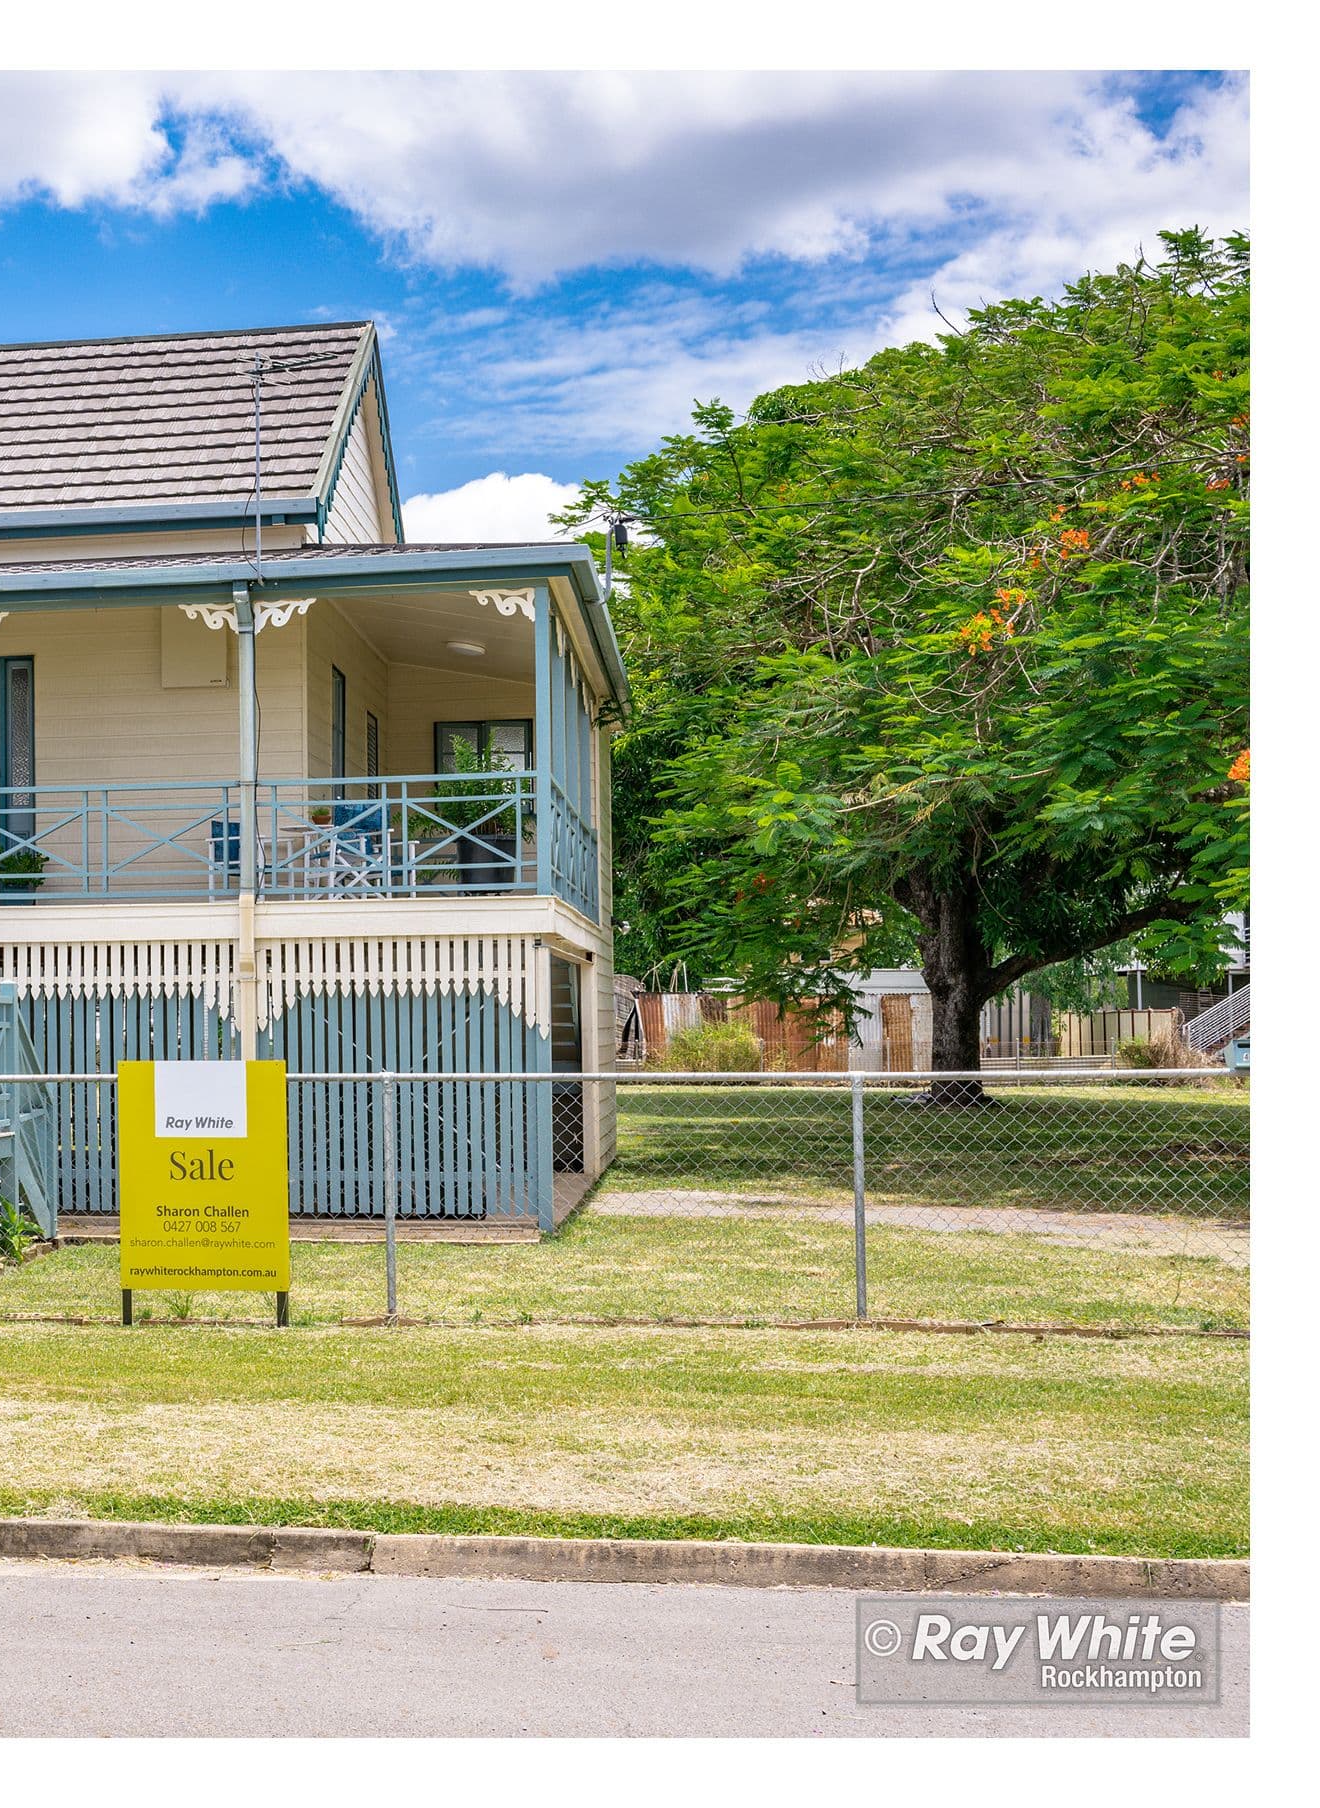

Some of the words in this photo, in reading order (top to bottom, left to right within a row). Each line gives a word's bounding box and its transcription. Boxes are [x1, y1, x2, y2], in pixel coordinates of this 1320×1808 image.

[166, 1116, 192, 1131] Ray
[195, 1116, 233, 1129] White
[170, 1149, 234, 1181] Sale
[156, 1205, 200, 1217] Sharon
[204, 1206, 249, 1218] Challen
[163, 1220, 191, 1232] 0427
[195, 1220, 217, 1233] 008
[220, 1221, 241, 1233] 567
[130, 1238, 276, 1250] sharon.challen@raywhite.com
[130, 1266, 277, 1278] raywhiterockhampton.com.au
